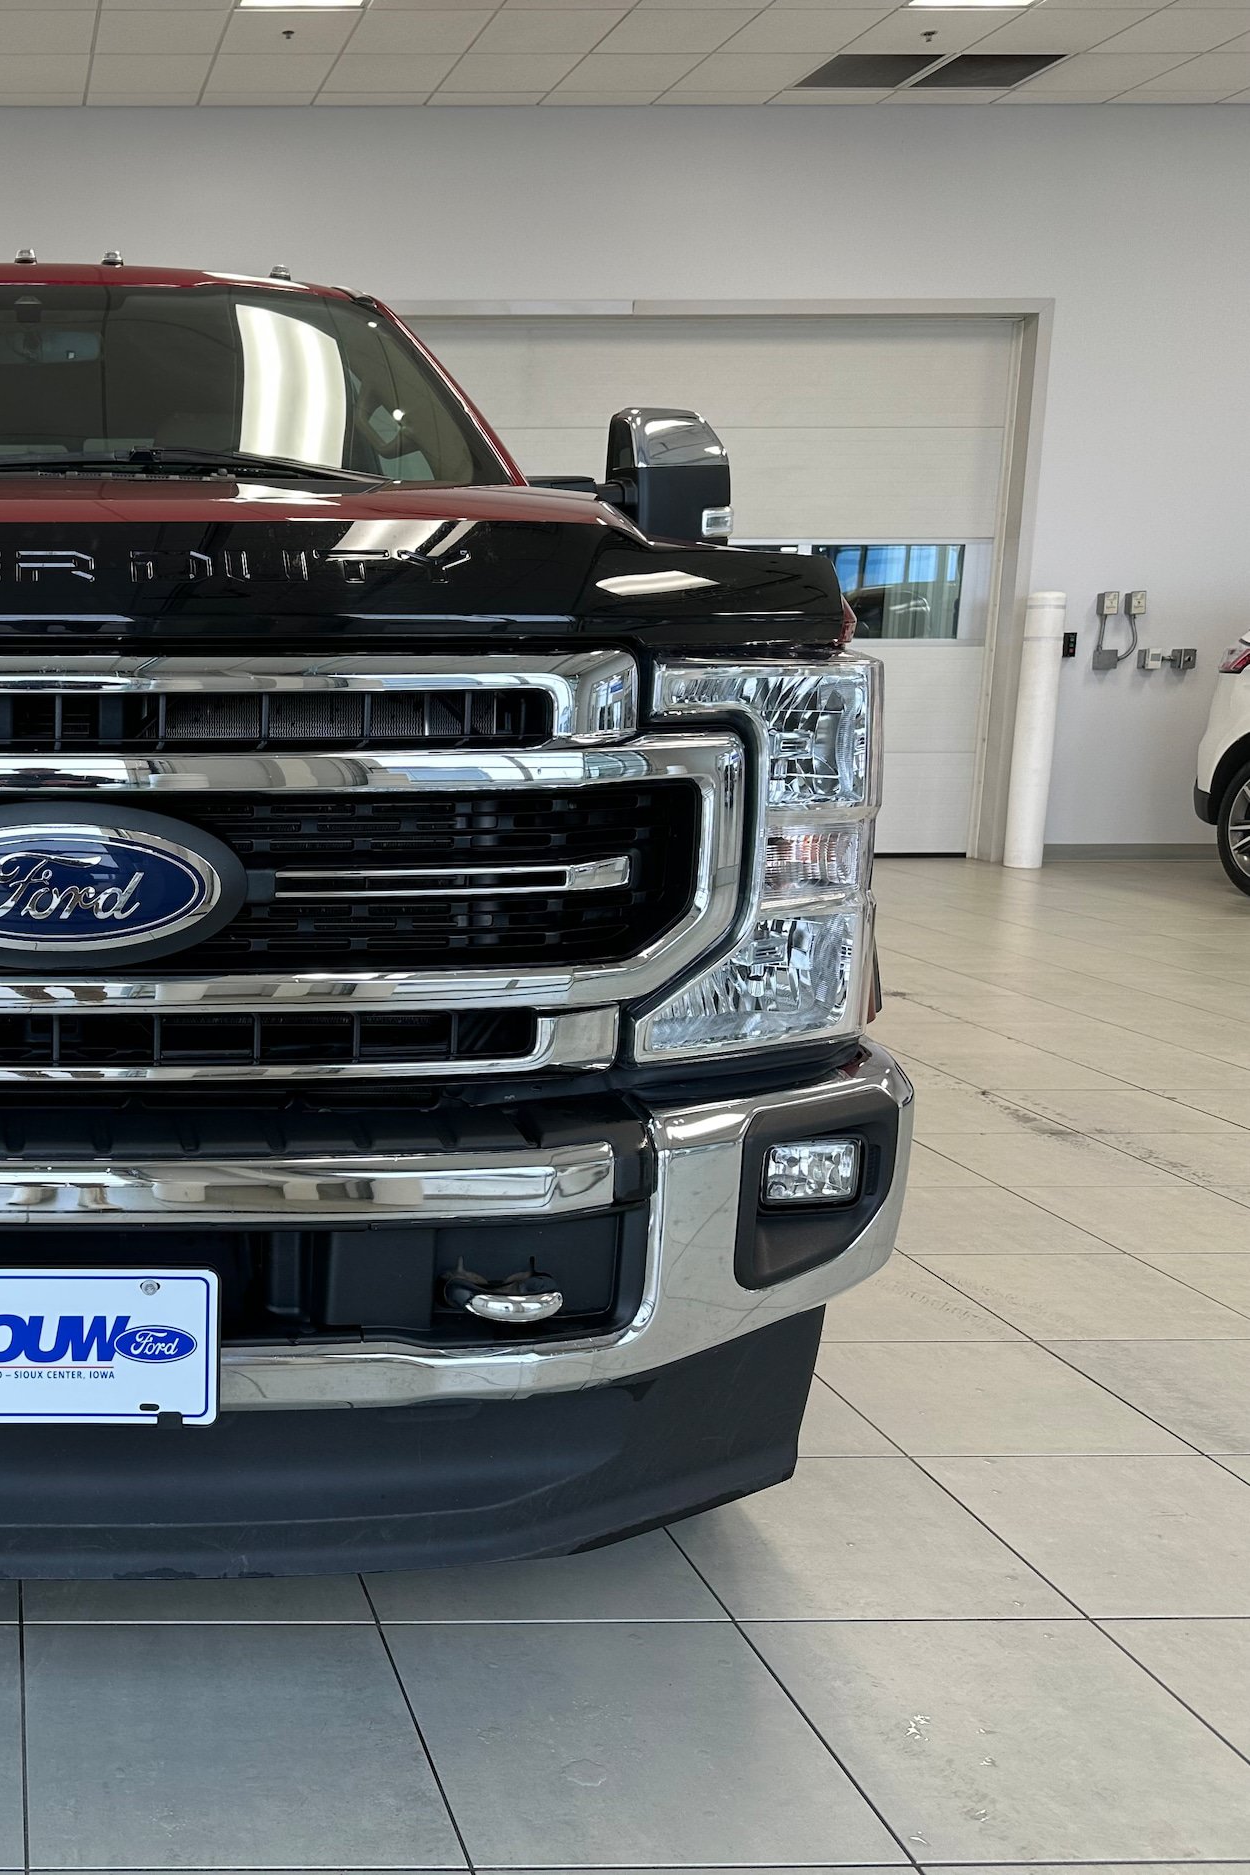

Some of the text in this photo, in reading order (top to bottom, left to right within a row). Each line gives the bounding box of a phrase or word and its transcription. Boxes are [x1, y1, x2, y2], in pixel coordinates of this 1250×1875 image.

[129, 548, 472, 584] DUTY
[130, 1330, 180, 1355] Ford
[14, 1370, 43, 1379] SIOUX
[47, 1370, 85, 1380] CENTER,
[90, 1370, 115, 1379] IOWA
